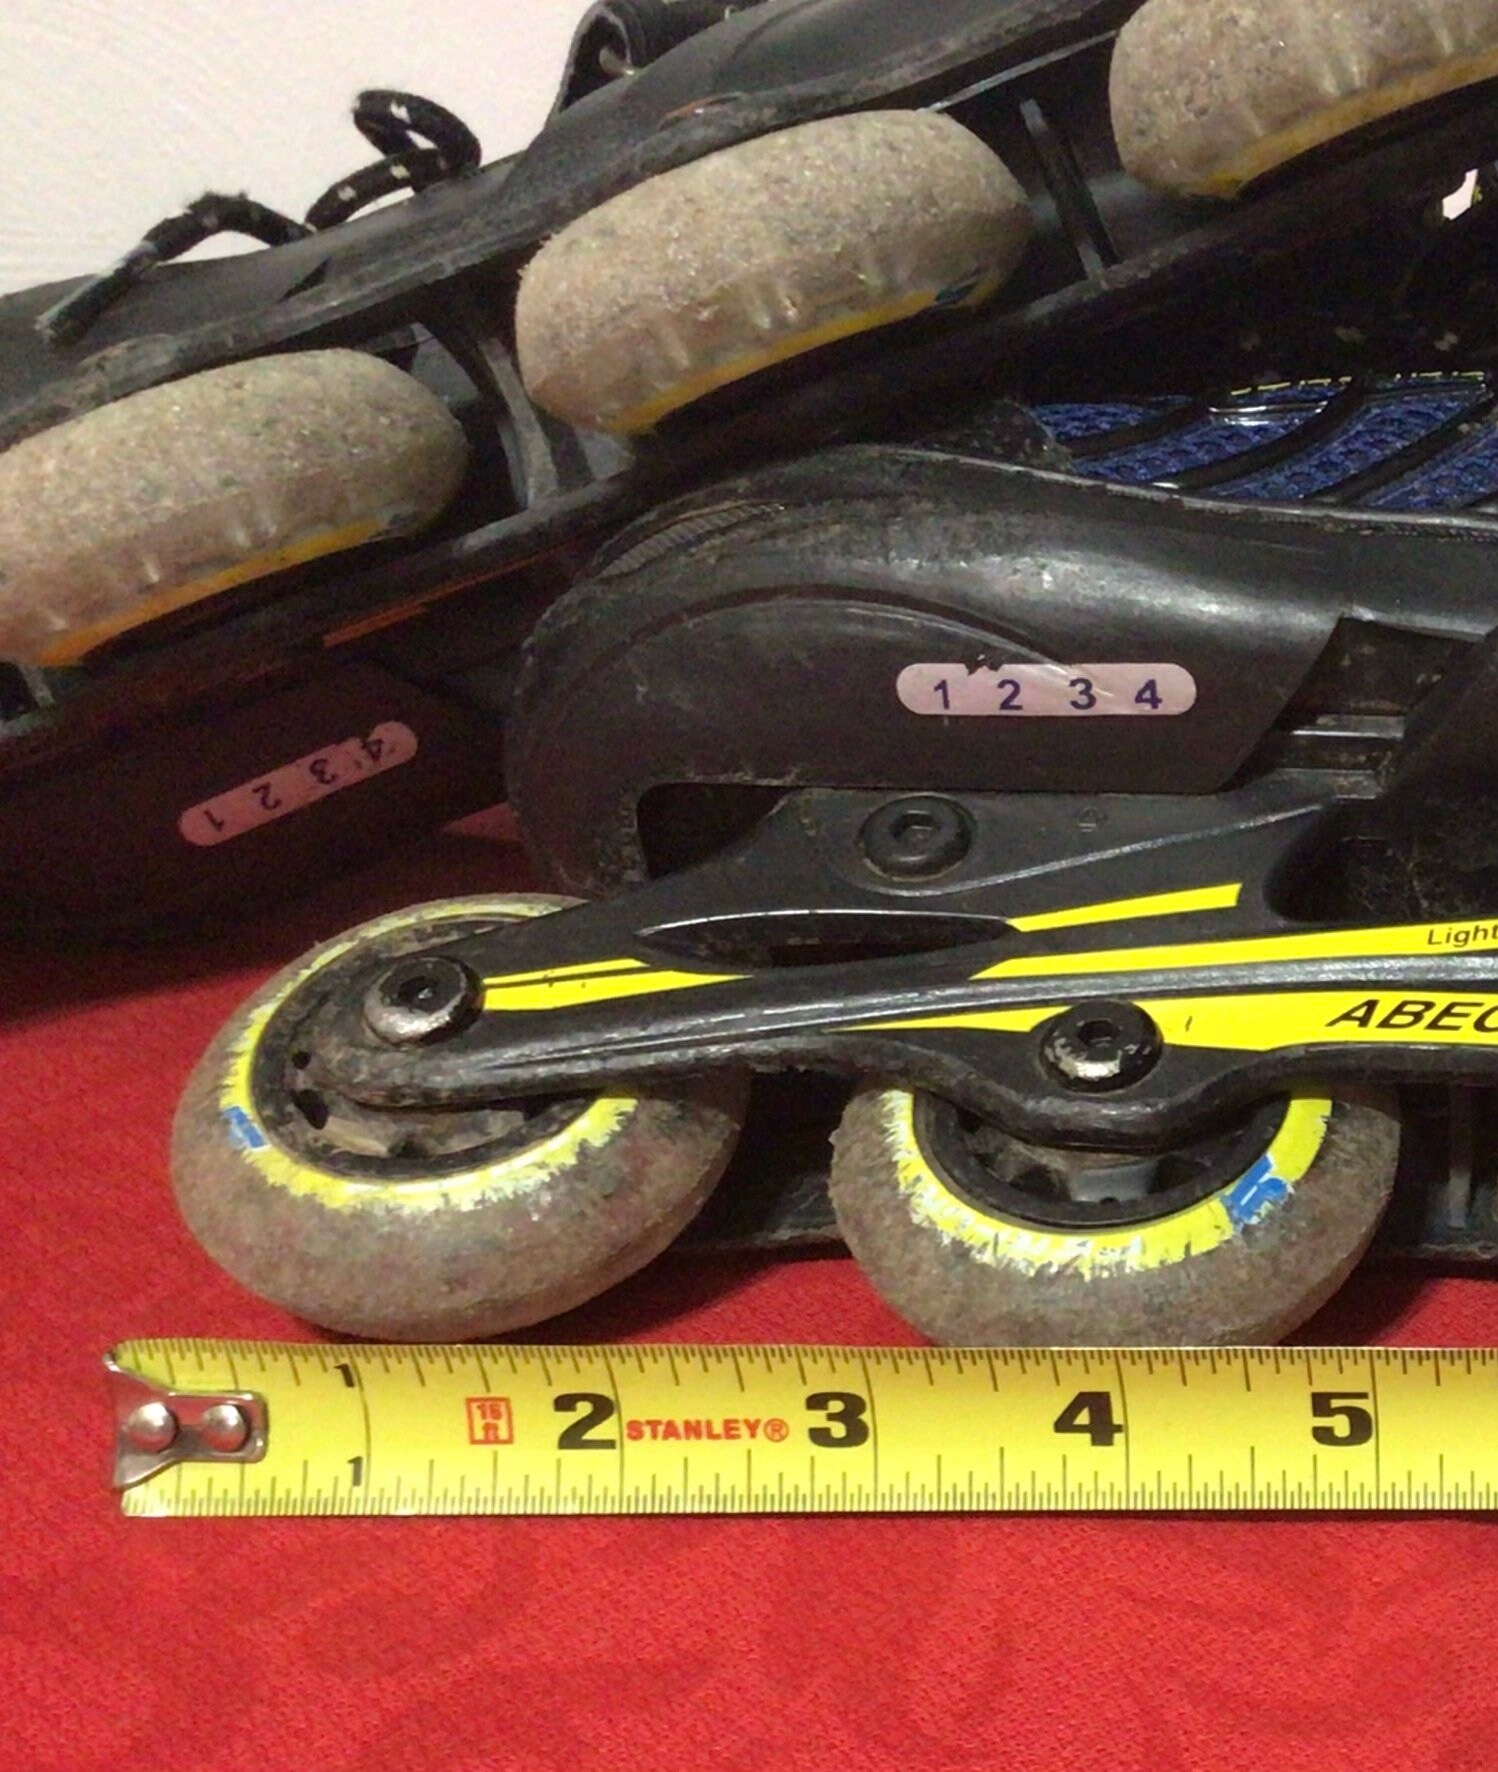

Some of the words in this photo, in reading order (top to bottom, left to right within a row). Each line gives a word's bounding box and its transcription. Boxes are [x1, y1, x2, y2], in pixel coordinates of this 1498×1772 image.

[934, 680, 950, 709] 1
[996, 679, 1023, 710] 2
[1068, 678, 1097, 710] 3
[1134, 679, 1163, 709] 4
[309, 757, 337, 785] 3
[252, 782, 282, 811] 2
[333, 1364, 357, 1388] 1
[553, 1393, 617, 1450] 2
[805, 1392, 867, 1448] 3
[1053, 1391, 1123, 1447] 4
[1310, 1391, 1373, 1446] 5
[346, 1456, 362, 1487] 1
